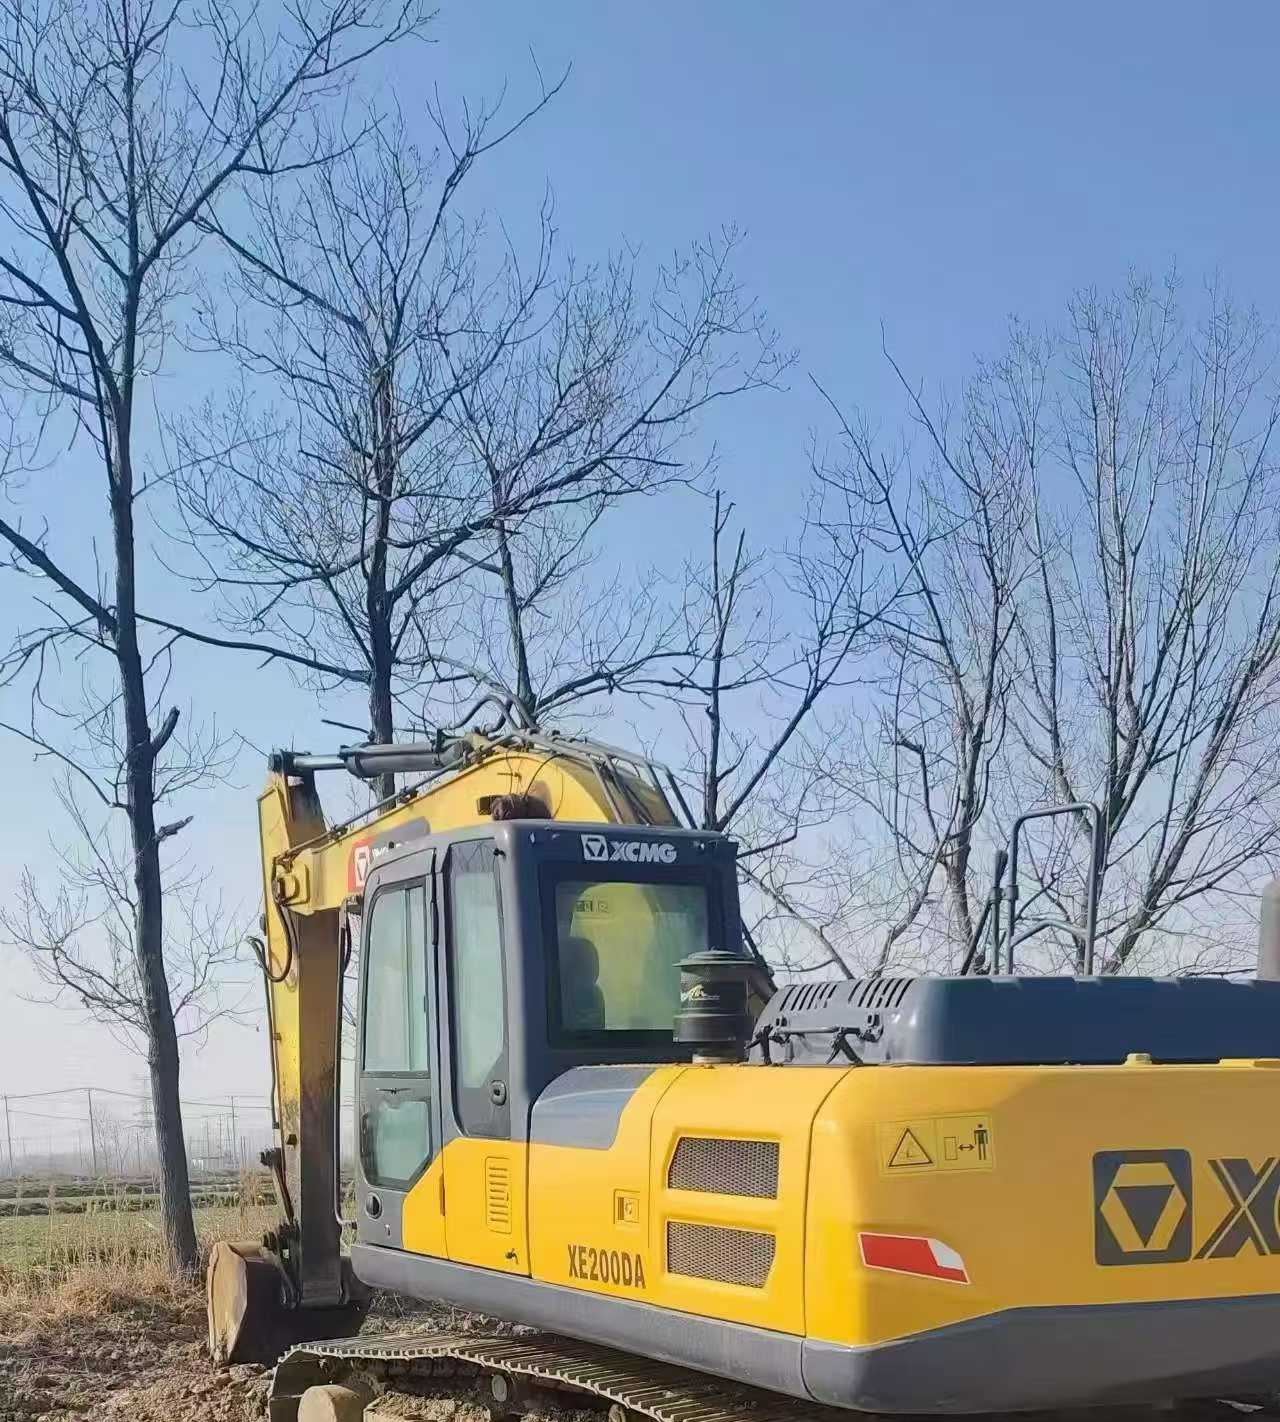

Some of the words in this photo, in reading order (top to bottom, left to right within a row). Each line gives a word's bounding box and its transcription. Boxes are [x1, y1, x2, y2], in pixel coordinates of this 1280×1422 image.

[608, 841, 677, 863] XCMG
[1192, 1157, 1280, 1259] X
[567, 1244, 647, 1289] XE200DA
